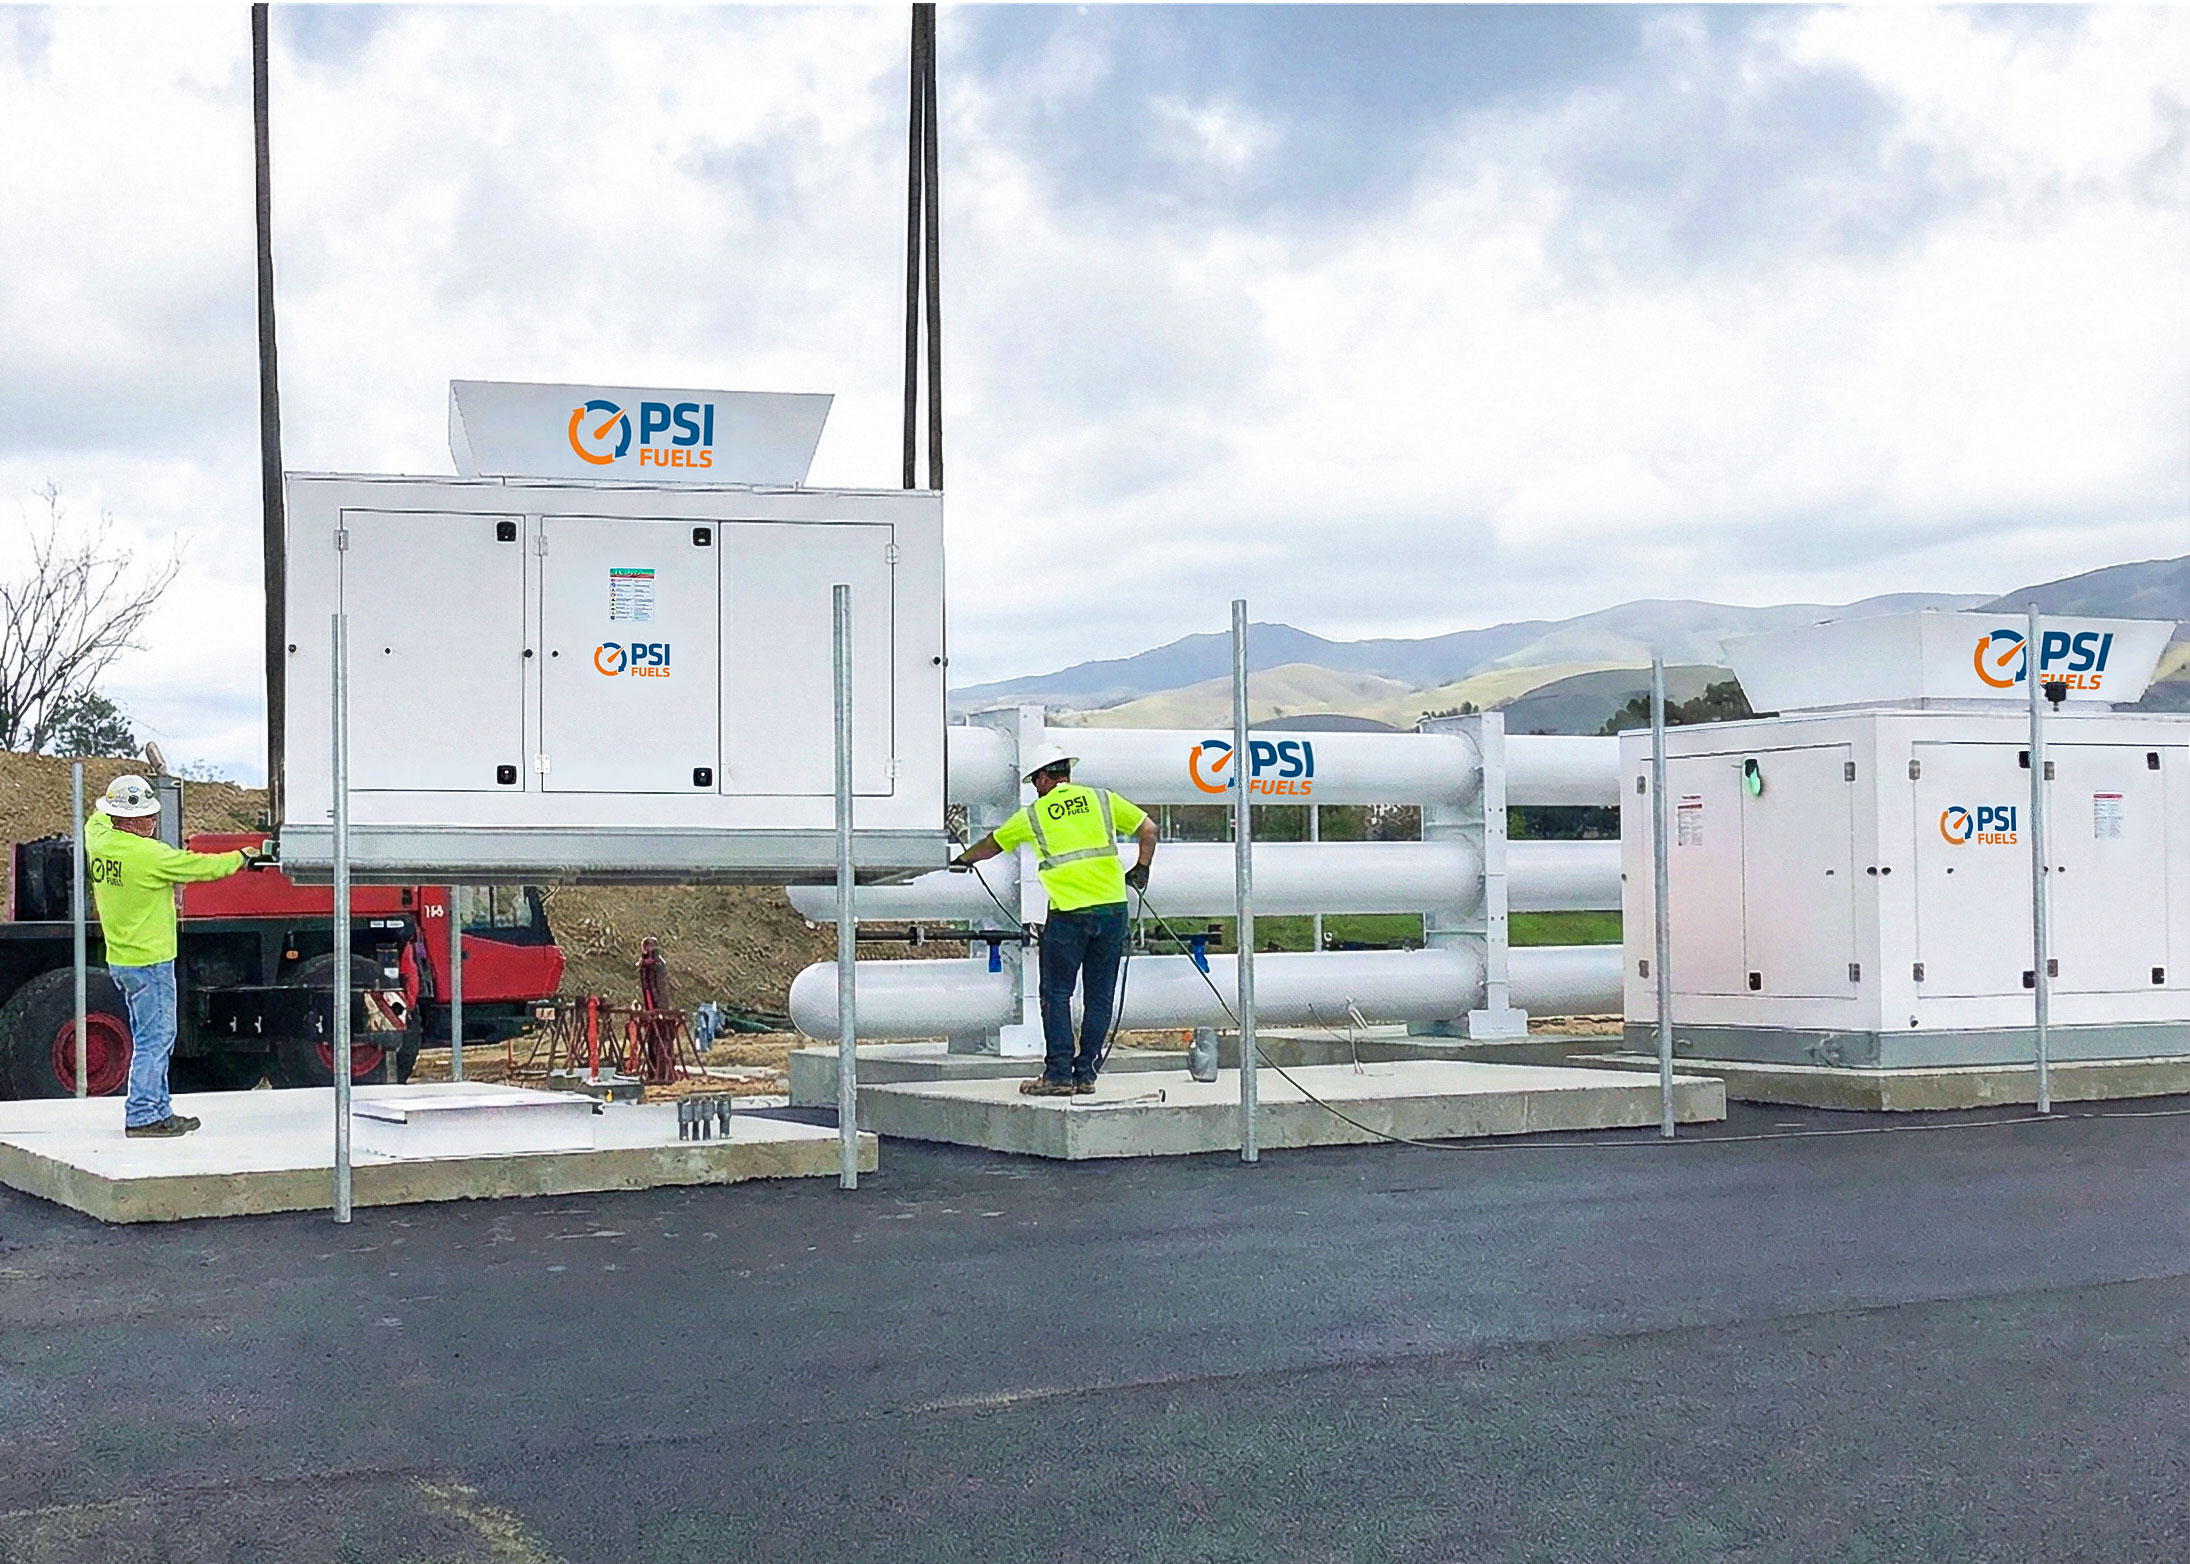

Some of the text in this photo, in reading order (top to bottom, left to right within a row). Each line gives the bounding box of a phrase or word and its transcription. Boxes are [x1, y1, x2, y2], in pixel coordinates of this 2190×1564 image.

[640, 402, 714, 446] PSI
[640, 448, 713, 468] FUELS
[631, 643, 671, 666] PSI
[2040, 631, 2114, 671] PSI
[631, 667, 671, 677] FUELS
[1249, 741, 1315, 778] PSI
[1249, 779, 1313, 795] FUELS
[1063, 795, 1088, 811] PSI
[1067, 807, 1090, 816] FUELS
[1977, 806, 2017, 831] PSI
[1977, 833, 2017, 844] FUELS
[106, 860, 122, 878] PSI
[106, 877, 124, 887] FUELS
